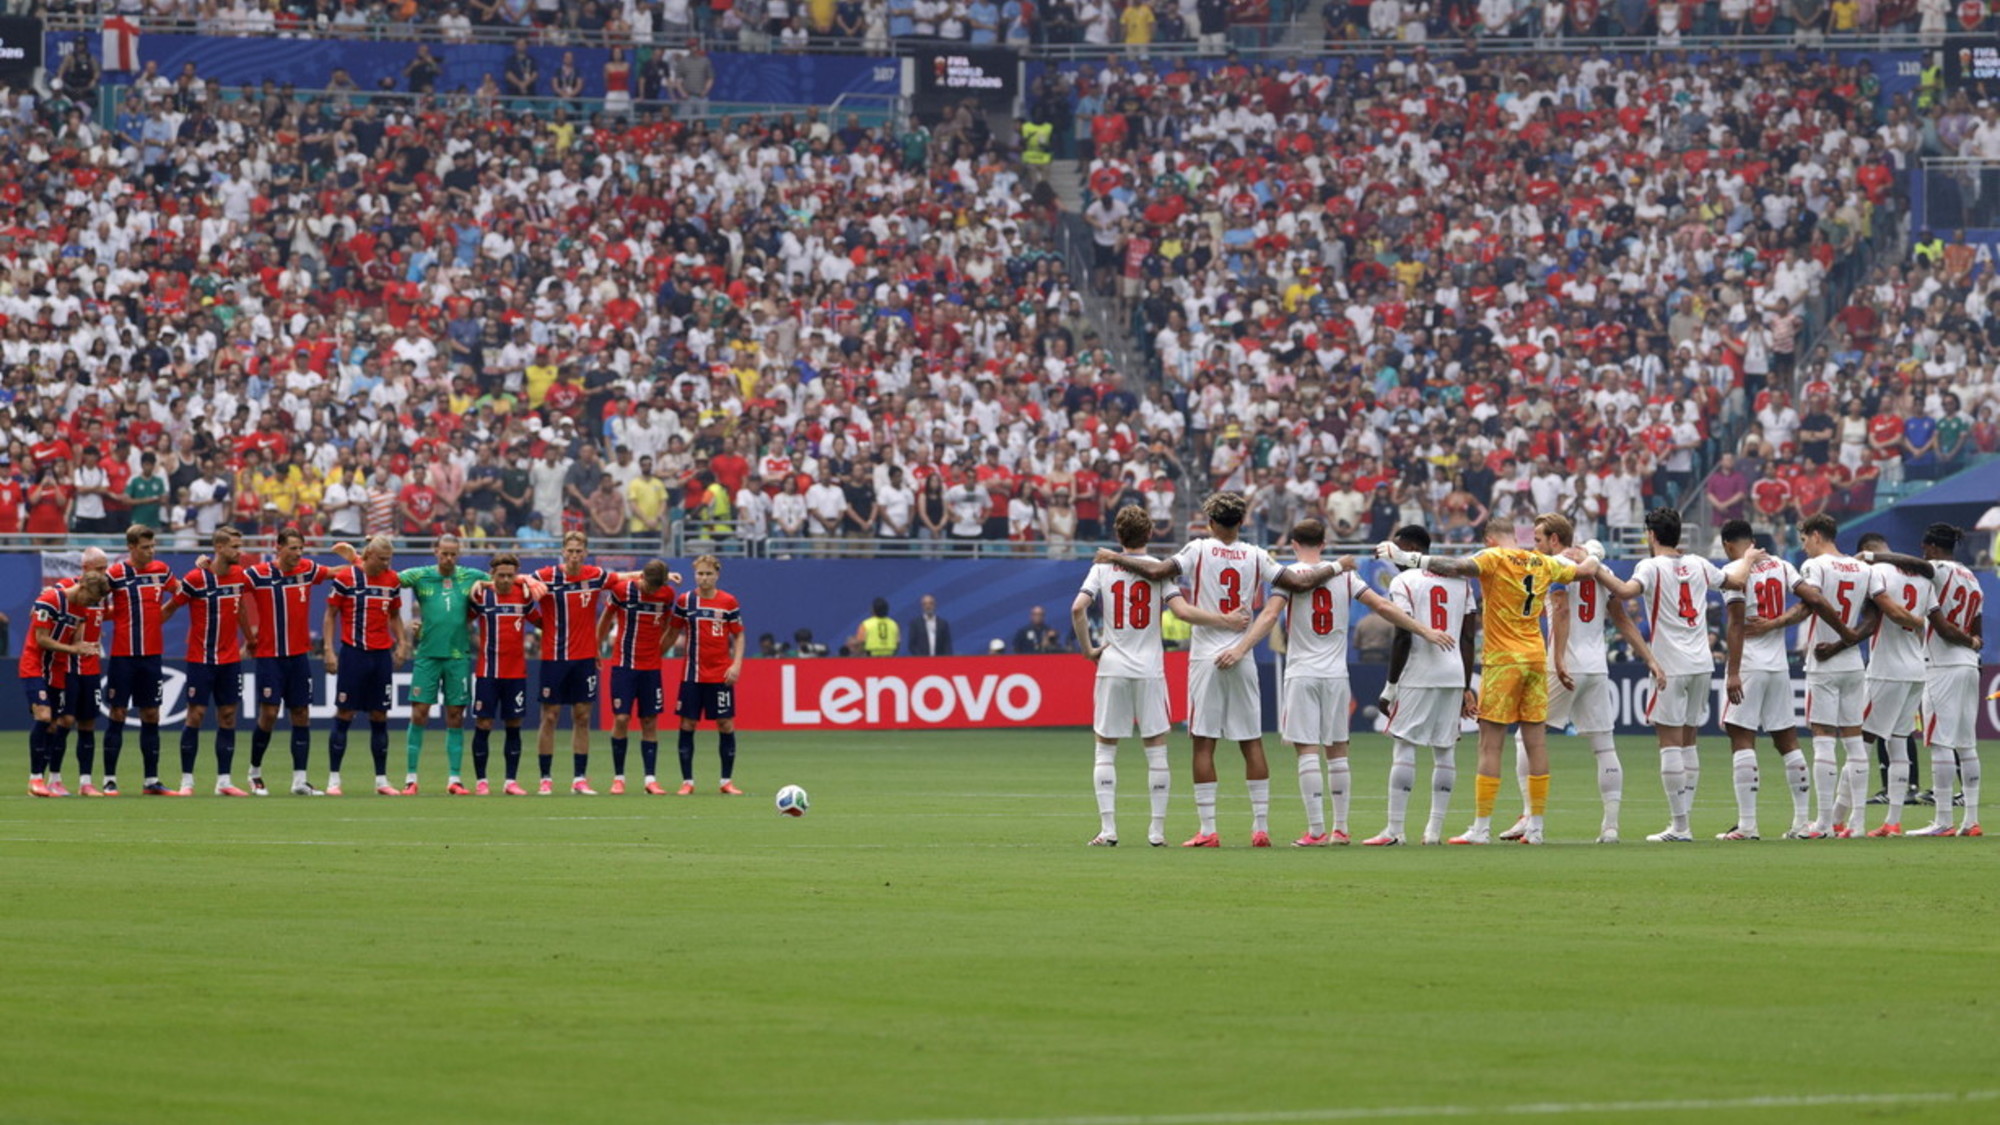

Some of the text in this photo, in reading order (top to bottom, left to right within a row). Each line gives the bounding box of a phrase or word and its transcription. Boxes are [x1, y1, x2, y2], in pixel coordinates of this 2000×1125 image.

[947, 56, 969, 66] FIFA
[947, 67, 984, 77] WORLD
[444, 596, 451, 613] 1
[1111, 580, 1151, 630] 18
[1219, 567, 1241, 614] 3
[1311, 586, 1334, 636] 8
[1430, 585, 1448, 632] 6
[1522, 574, 1536, 617] 1
[1578, 577, 1597, 623] 9
[1678, 581, 1699, 627] 4
[1837, 580, 1855, 625] 5
[1903, 584, 1918, 632] 2
[1946, 584, 1981, 634] 20
[462, 677, 468, 693] 1
[515, 691, 524, 707] 6
[717, 691, 731, 708] 21
[781, 664, 1042, 724] Lenovo
